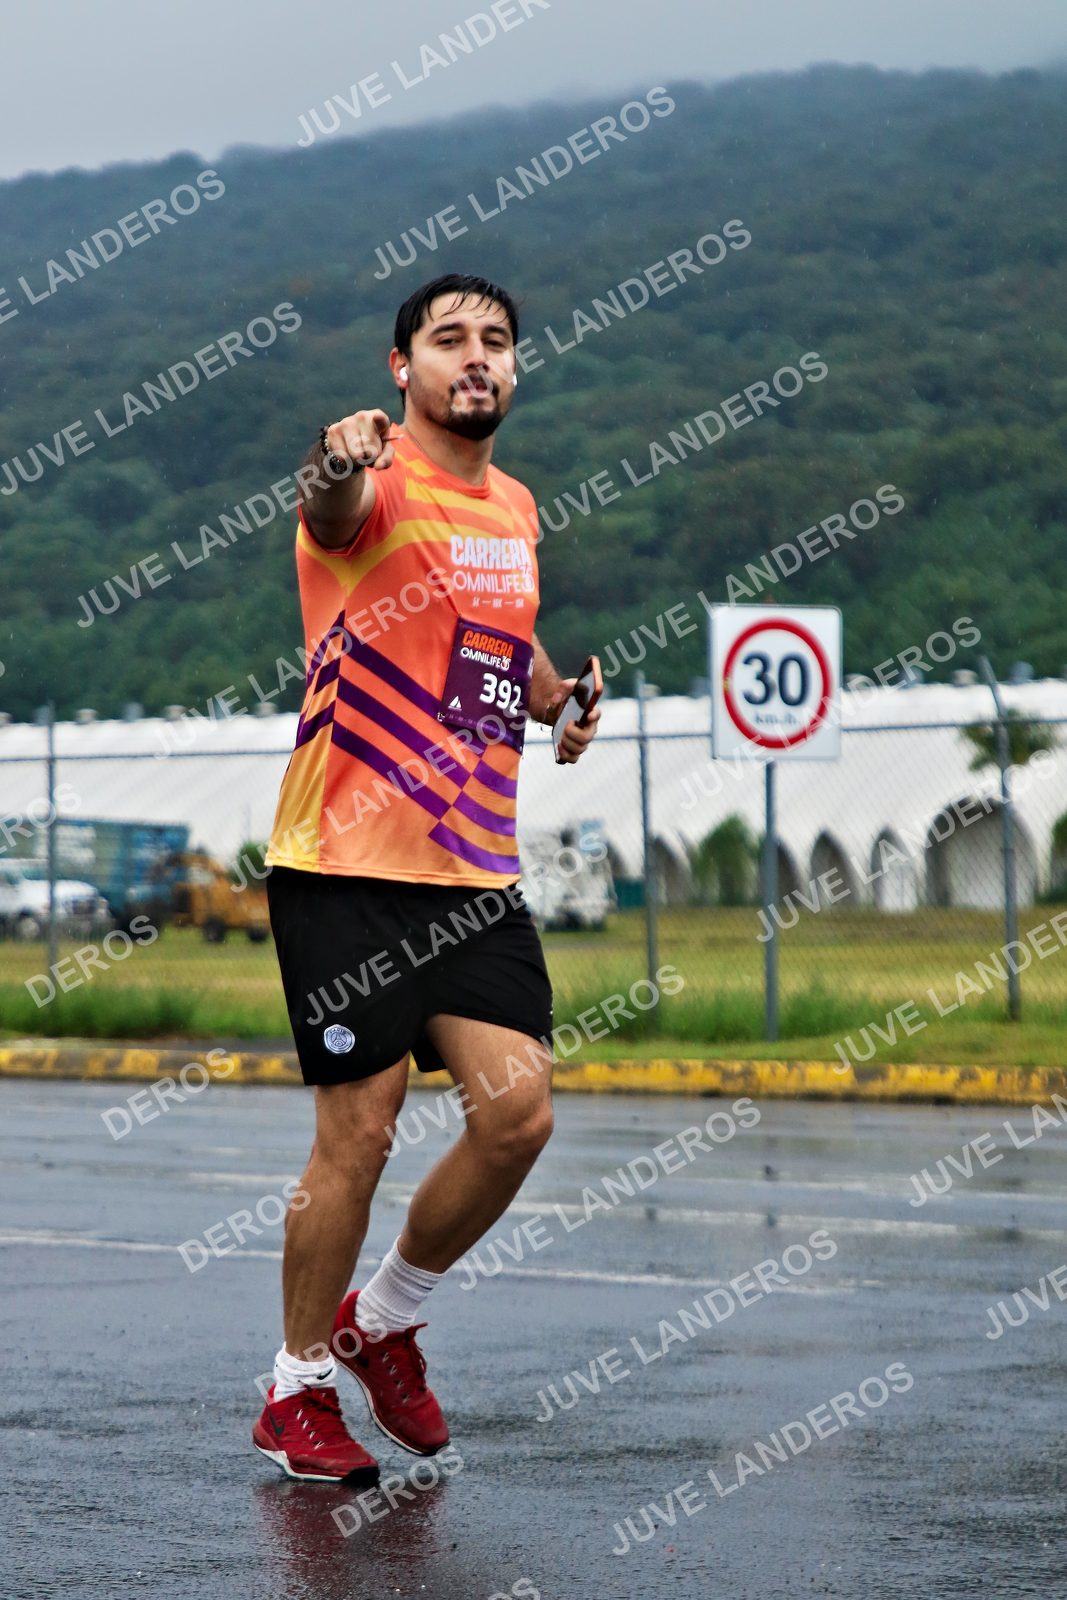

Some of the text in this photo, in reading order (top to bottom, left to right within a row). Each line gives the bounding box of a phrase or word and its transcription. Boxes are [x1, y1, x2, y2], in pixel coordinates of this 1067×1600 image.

[450, 535, 531, 569] CARRERA
[453, 570, 520, 593] OMNILIFE
[460, 647, 502, 669] OMNILIFE
[463, 630, 514, 658] CARRERA
[479, 672, 522, 715] 392
[743, 652, 810, 706] 30
